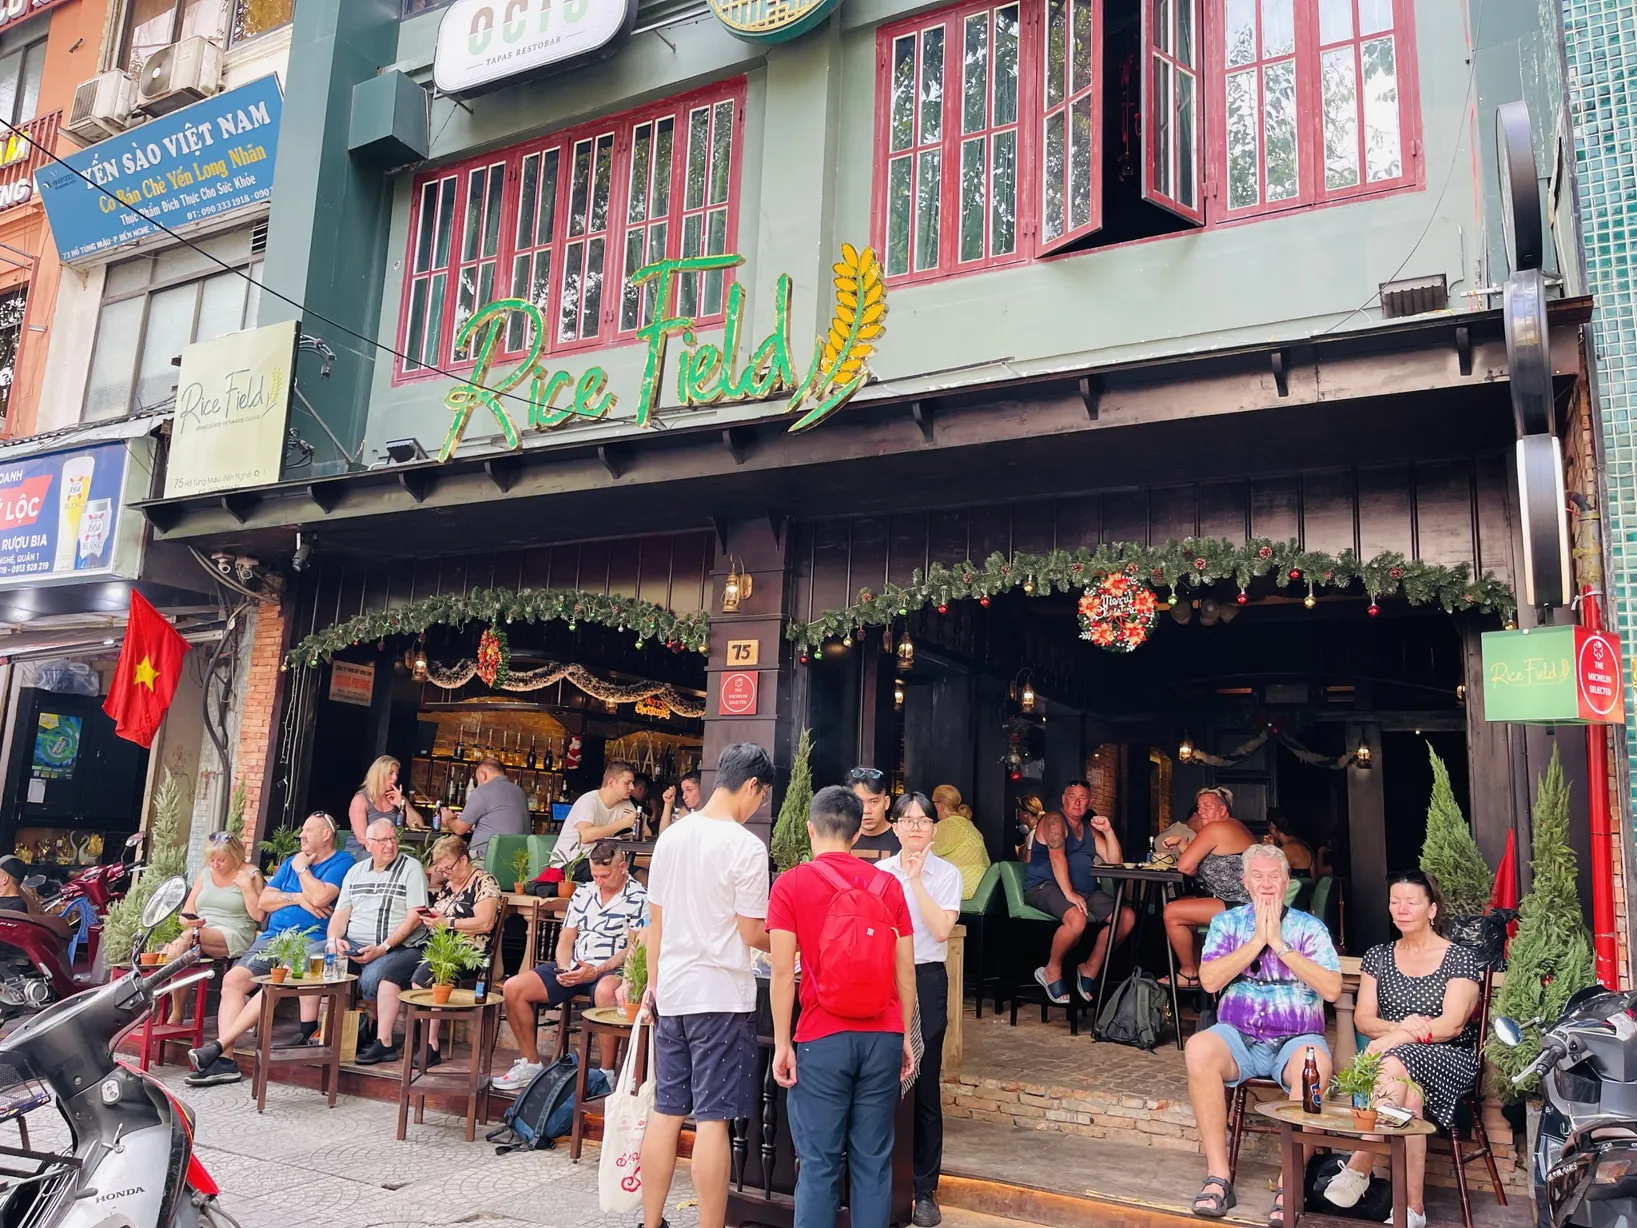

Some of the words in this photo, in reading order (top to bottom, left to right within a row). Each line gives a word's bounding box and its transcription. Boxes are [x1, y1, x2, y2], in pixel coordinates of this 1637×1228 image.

[486, 52, 513, 66] TAPAS
[516, 36, 561, 57] RESTOBAR
[123, 141, 162, 175] SÀO
[163, 123, 215, 157] VIỆT
[216, 101, 272, 139] NAM
[0, 177, 30, 207] NG
[142, 176, 167, 199] Chè
[167, 165, 193, 191] Yến
[193, 159, 229, 182] Long
[200, 186, 217, 201] Cho
[233, 172, 257, 190] Khỏe
[201, 206, 217, 216] 090
[217, 200, 232, 211] 333
[231, 195, 250, 206] 1918
[254, 188, 270, 199] 090
[62, 252, 71, 260] 73
[438, 297, 619, 464] Rice
[631, 253, 798, 430] Field
[180, 382, 221, 434] Rice
[225, 368, 264, 419] Field
[173, 478, 184, 489] 75
[5, 493, 40, 524] LỘC
[30, 533, 47, 547] BIA
[12, 563, 26, 573] 0913
[38, 561, 49, 570] 219
[731, 644, 751, 660] 75
[1594, 661, 1604, 670] THE
[1490, 661, 1524, 690] Rice
[1524, 657, 1557, 685] Field
[1587, 673, 1612, 683] MICHELIN
[1588, 685, 1612, 696] SELECTED
[95, 1186, 146, 1204] HONDA
